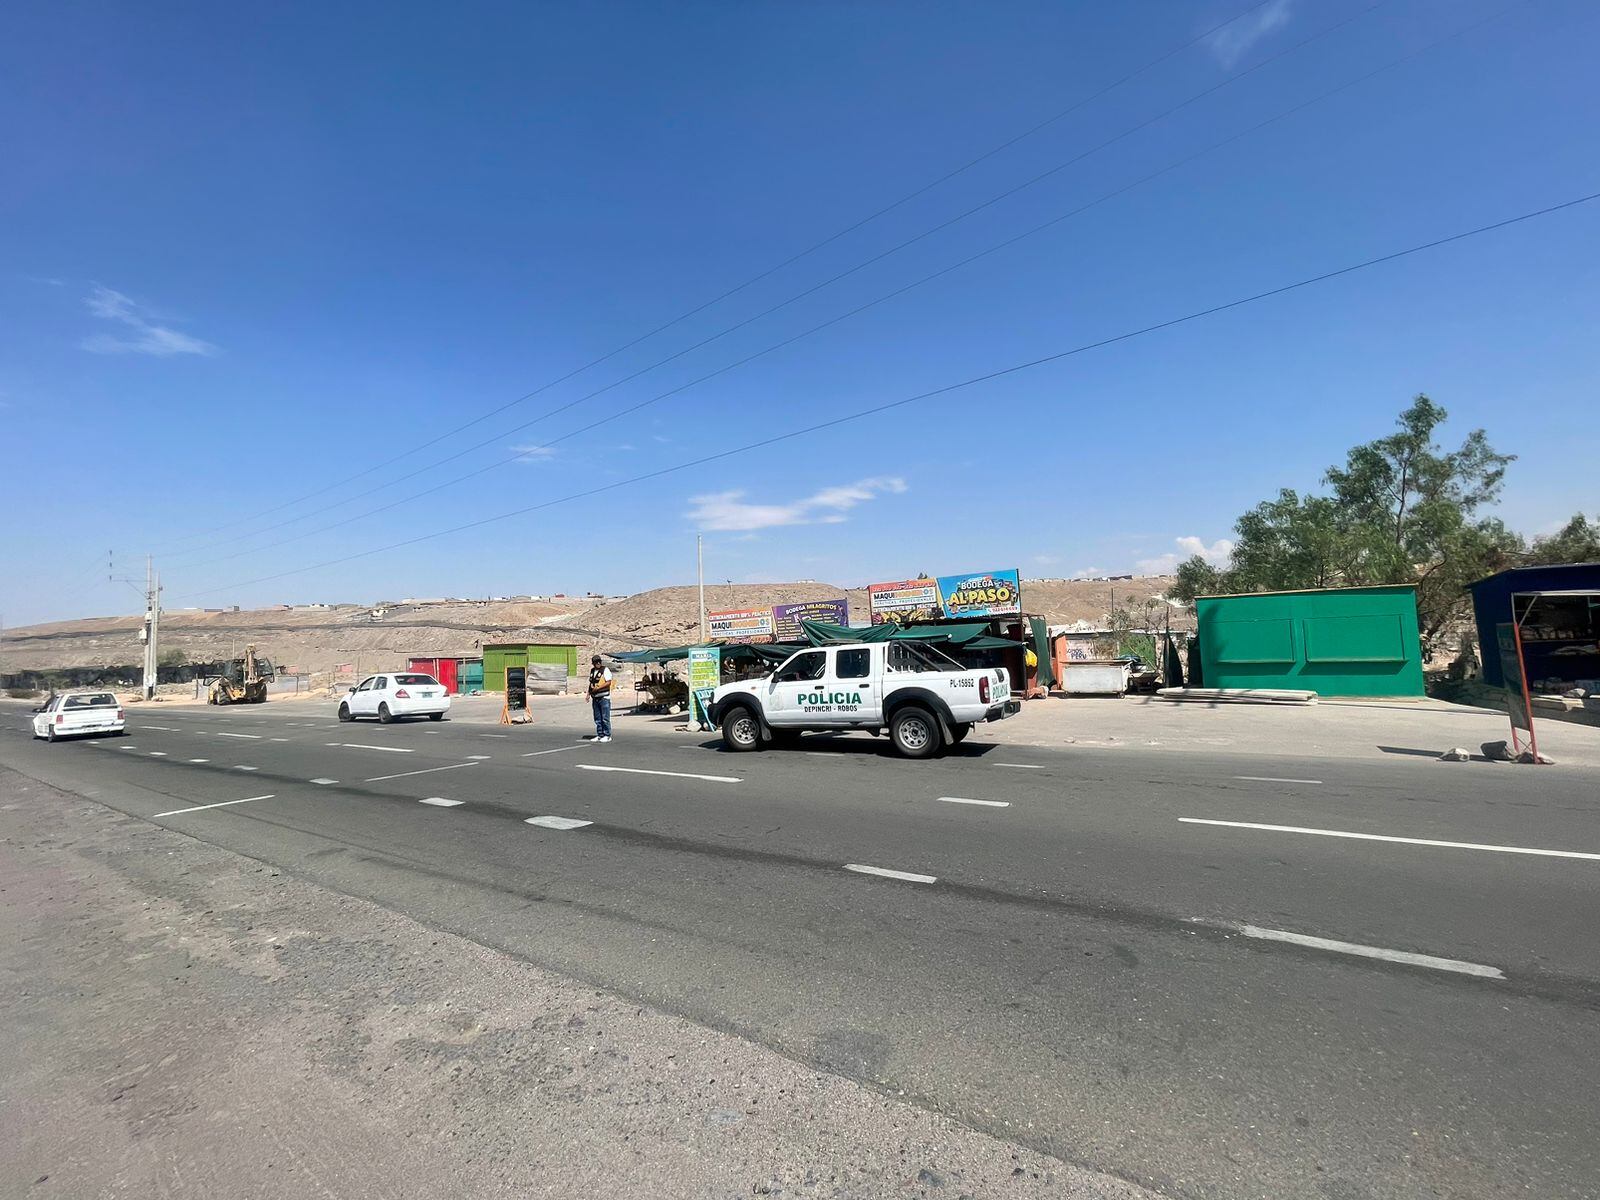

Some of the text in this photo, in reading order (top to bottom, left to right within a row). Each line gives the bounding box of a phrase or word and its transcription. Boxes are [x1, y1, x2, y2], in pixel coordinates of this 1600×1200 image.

[961, 580, 994, 590] BODEGA
[948, 588, 1010, 606] AL PASO
[785, 605, 806, 615] BODEGA
[797, 692, 862, 705] POLICIA
[804, 705, 832, 713] DEPINCRI
